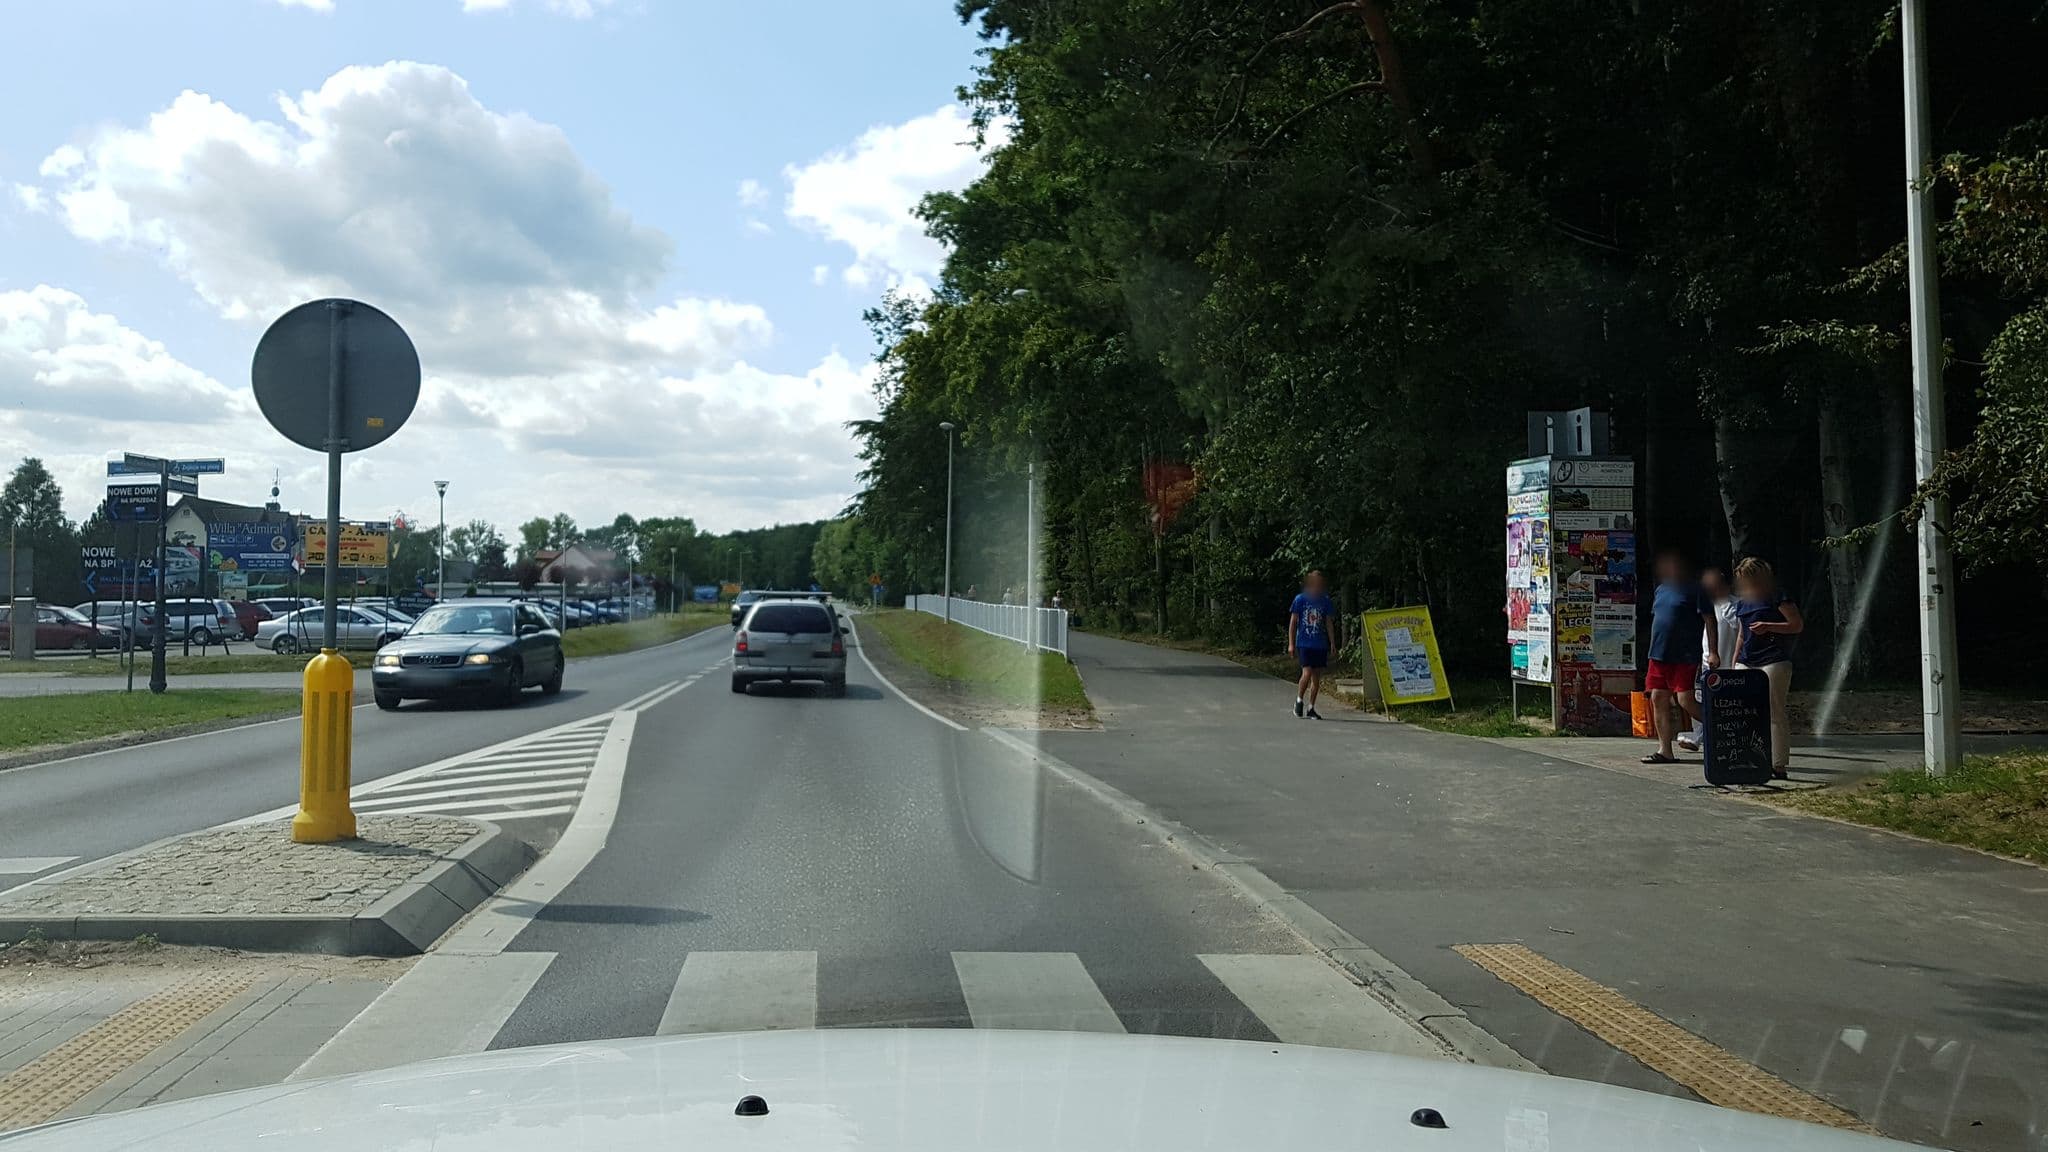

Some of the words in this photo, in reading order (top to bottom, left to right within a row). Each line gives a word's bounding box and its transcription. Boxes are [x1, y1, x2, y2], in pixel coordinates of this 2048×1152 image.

[108, 487, 133, 497] NOWE
[134, 485, 159, 496] DOMY
[82, 546, 116, 558] NOWE
[84, 559, 99, 568] NA
[1563, 615, 1593, 629] LEGO
[1723, 676, 1745, 688] pepsi
